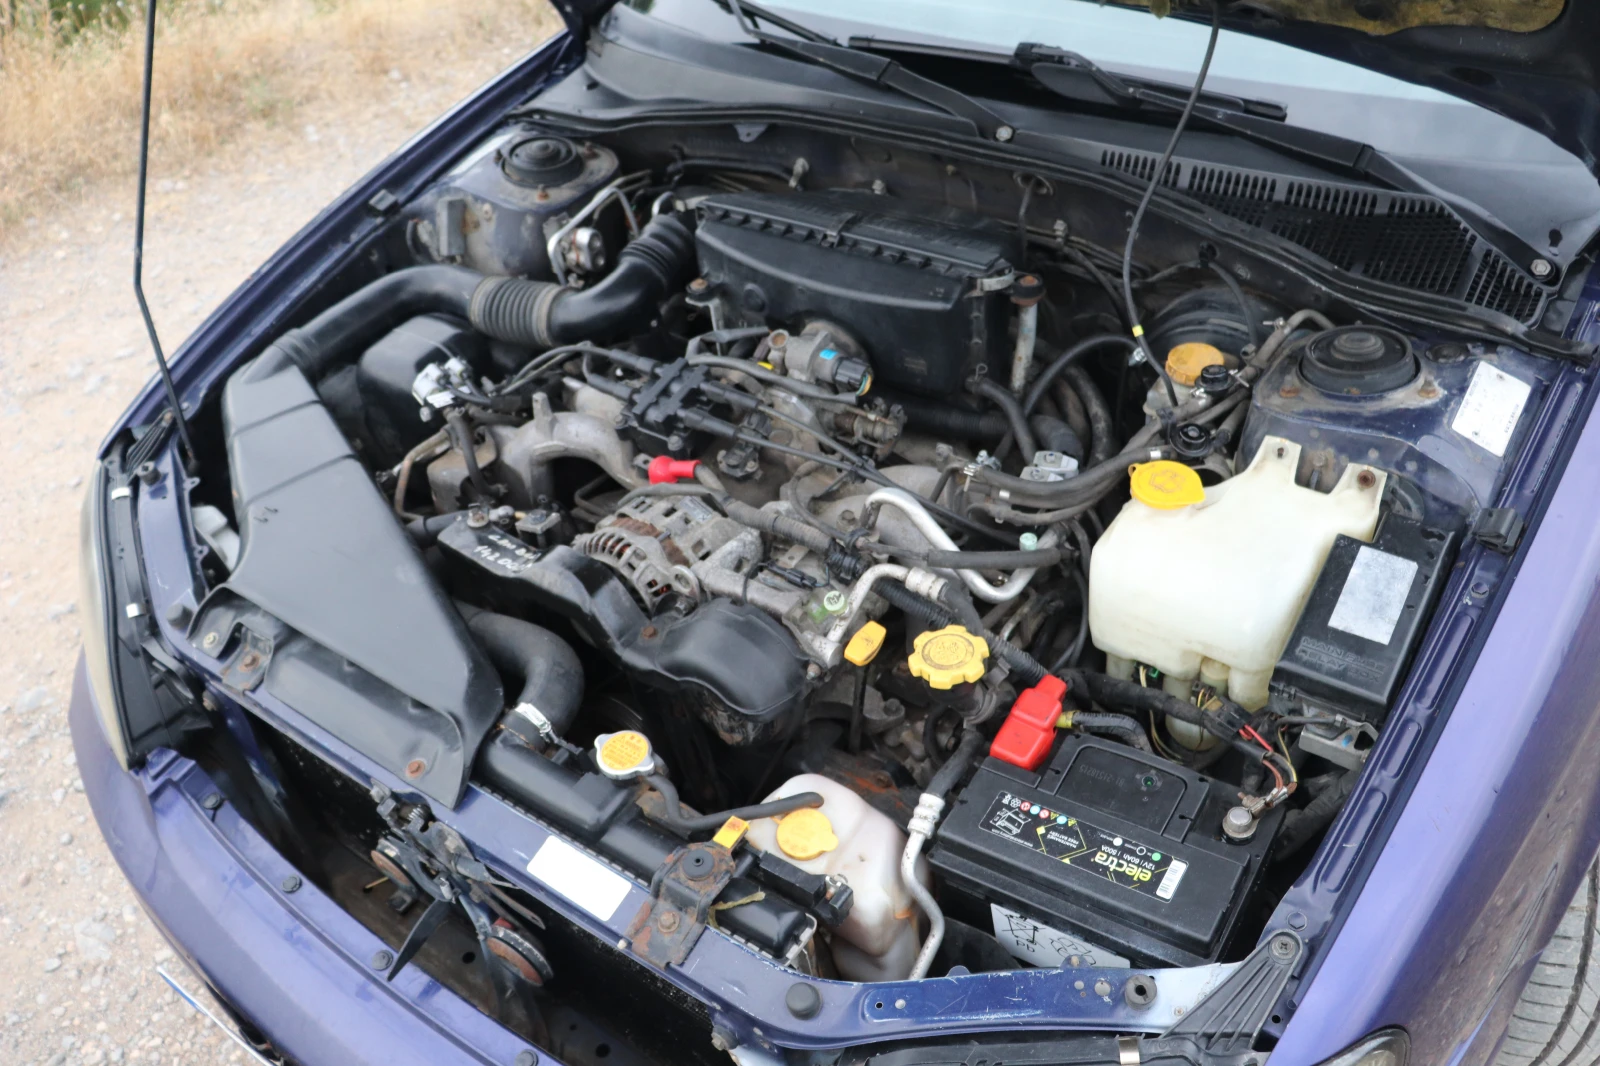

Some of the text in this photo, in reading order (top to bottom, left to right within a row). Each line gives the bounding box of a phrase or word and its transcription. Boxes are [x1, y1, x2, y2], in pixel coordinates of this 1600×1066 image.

[1301, 637, 1343, 656] MAIN
[1297, 648, 1346, 669] RELAY
[1094, 851, 1152, 882] electra
[1016, 940, 1035, 952] Pb
